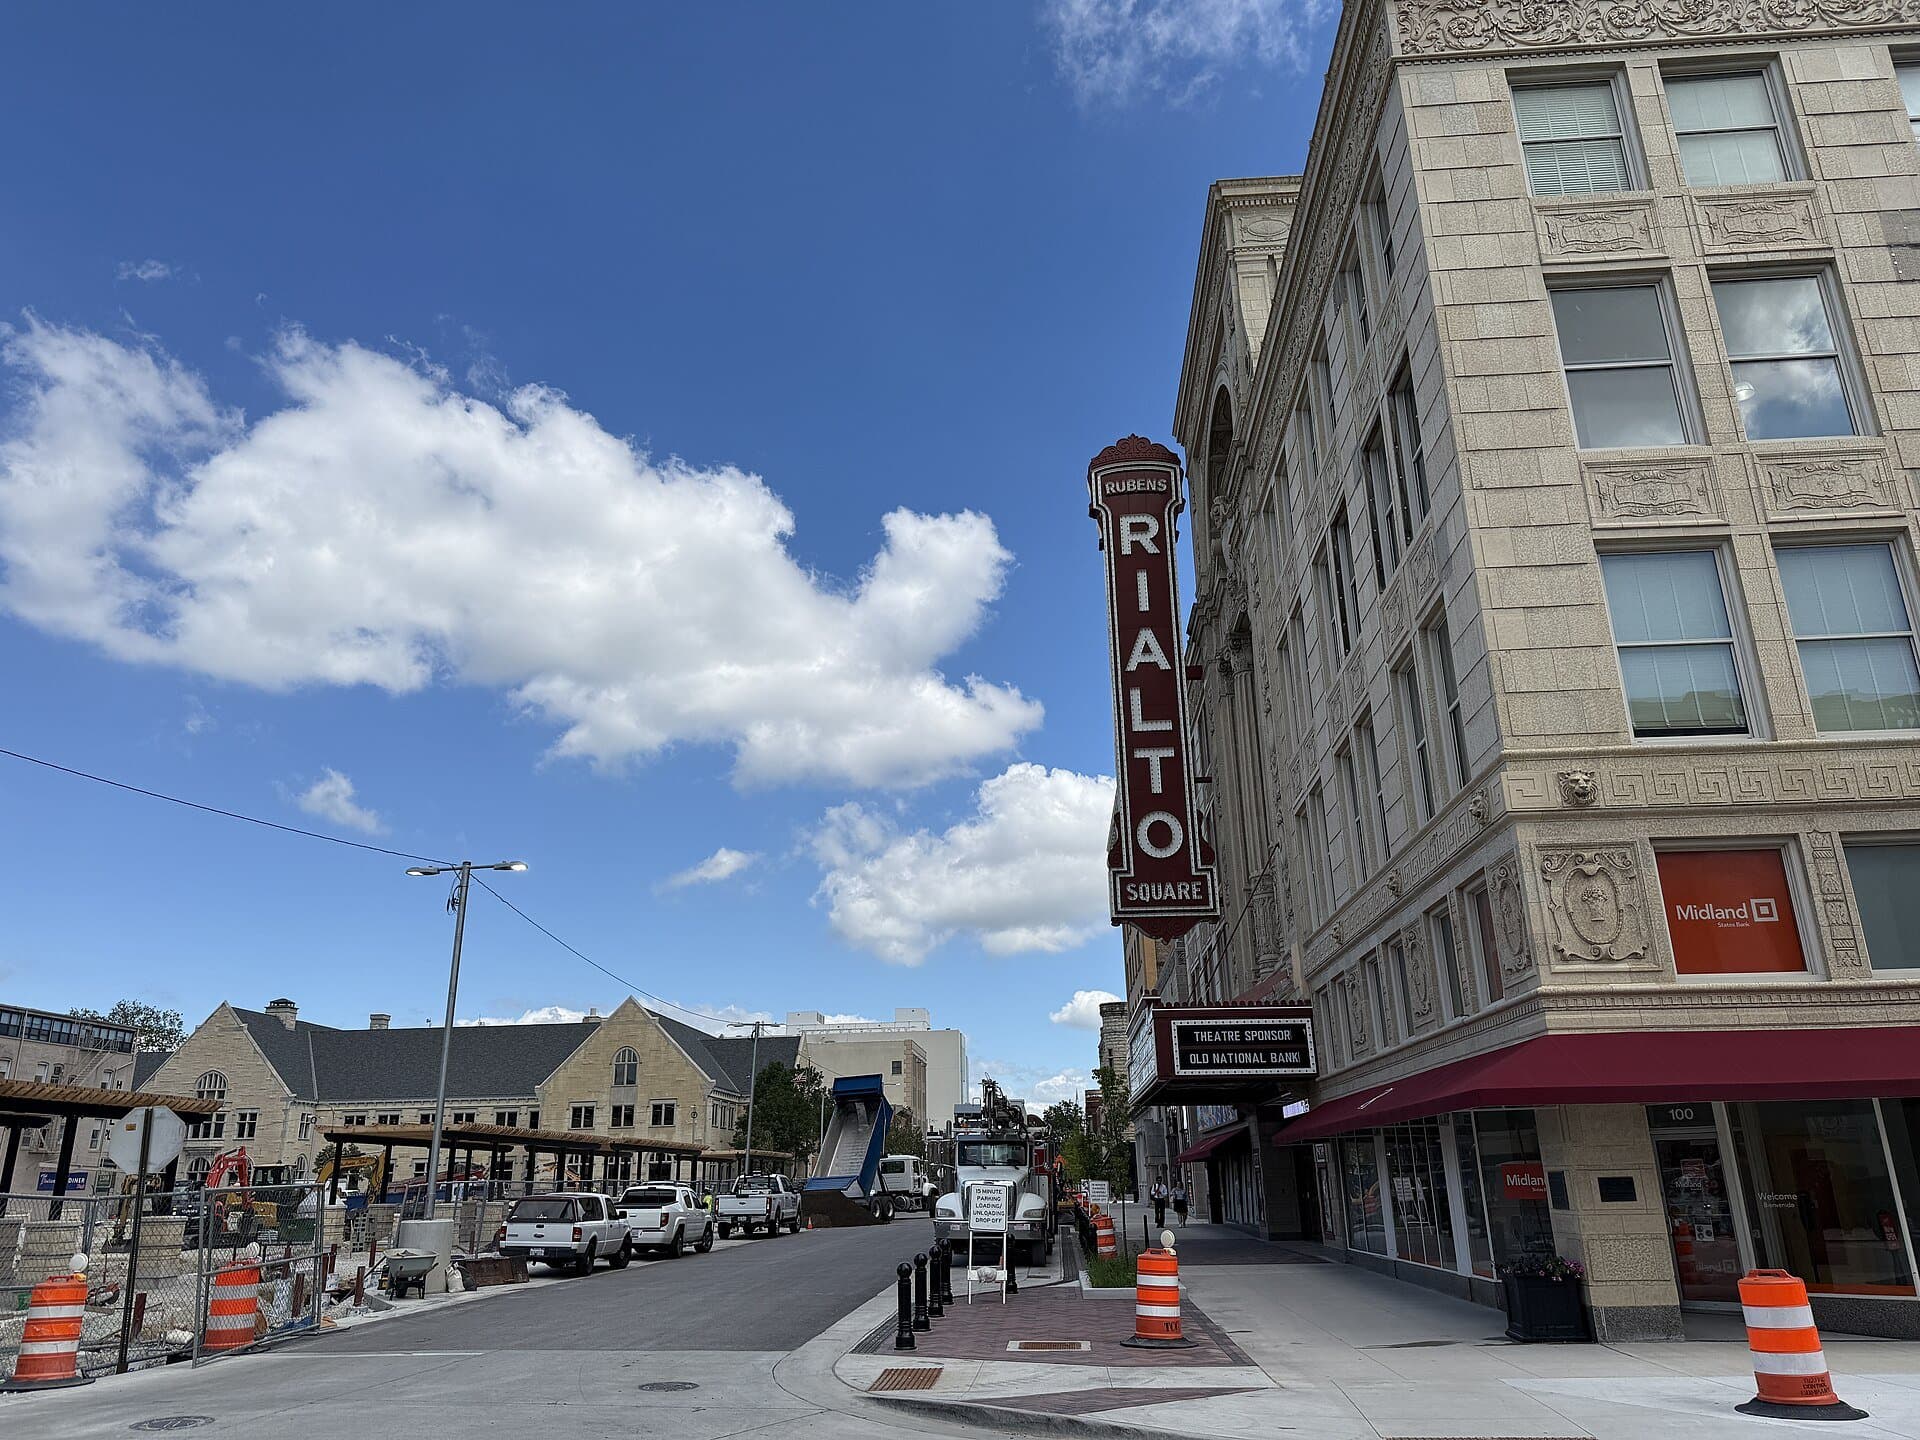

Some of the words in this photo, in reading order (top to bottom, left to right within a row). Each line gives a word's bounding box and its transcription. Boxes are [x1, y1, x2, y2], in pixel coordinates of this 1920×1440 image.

[1105, 479, 1167, 494] RUBENS
[1119, 513, 1184, 859] RIALTO
[1126, 881, 1203, 903] SQUARE
[1676, 903, 1748, 920] Midland
[1193, 1031, 1241, 1042] THEATRE
[1244, 1030, 1291, 1041] SPONSOR
[1189, 1053, 1209, 1064] OLD
[1212, 1052, 1267, 1064] NATIONAL
[1270, 1051, 1299, 1063] BANK
[1668, 1108, 1694, 1121] 100
[1506, 1173, 1545, 1186] Midlan
[1757, 1192, 1798, 1201] Welcome
